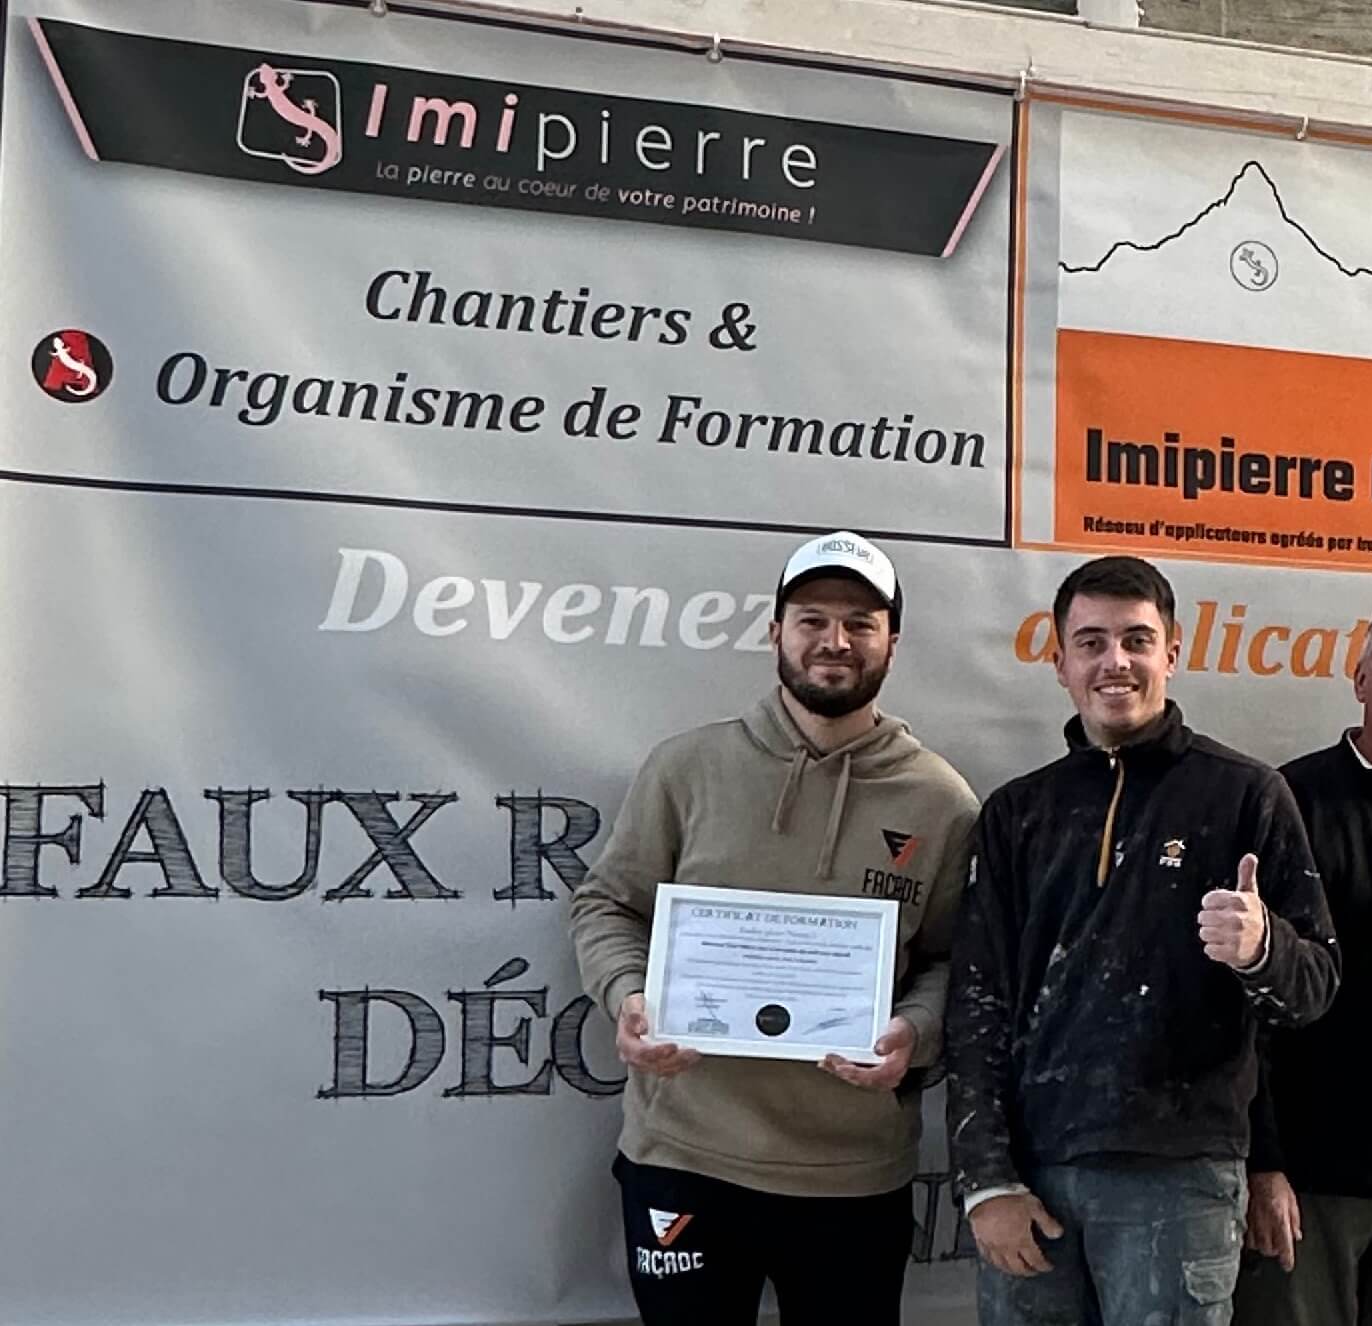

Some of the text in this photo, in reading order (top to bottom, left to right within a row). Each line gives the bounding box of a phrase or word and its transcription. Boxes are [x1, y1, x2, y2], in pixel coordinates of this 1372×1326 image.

[364, 83, 818, 189] Imipierre
[406, 162, 476, 188] pierre
[483, 174, 510, 191] au
[518, 178, 578, 198] coeur
[584, 182, 611, 202] de
[616, 187, 675, 211] votre
[682, 195, 802, 224] patrimoine
[806, 207, 817, 225] !
[364, 269, 758, 351] Chantiers &
[155, 351, 988, 468] Organisme de Formation
[1085, 427, 1355, 500] Imipierre
[1083, 516, 1146, 536] Réseau
[1270, 531, 1324, 551] agréés
[1327, 536, 1353, 553] par
[0, 778, 463, 902] FAUX
